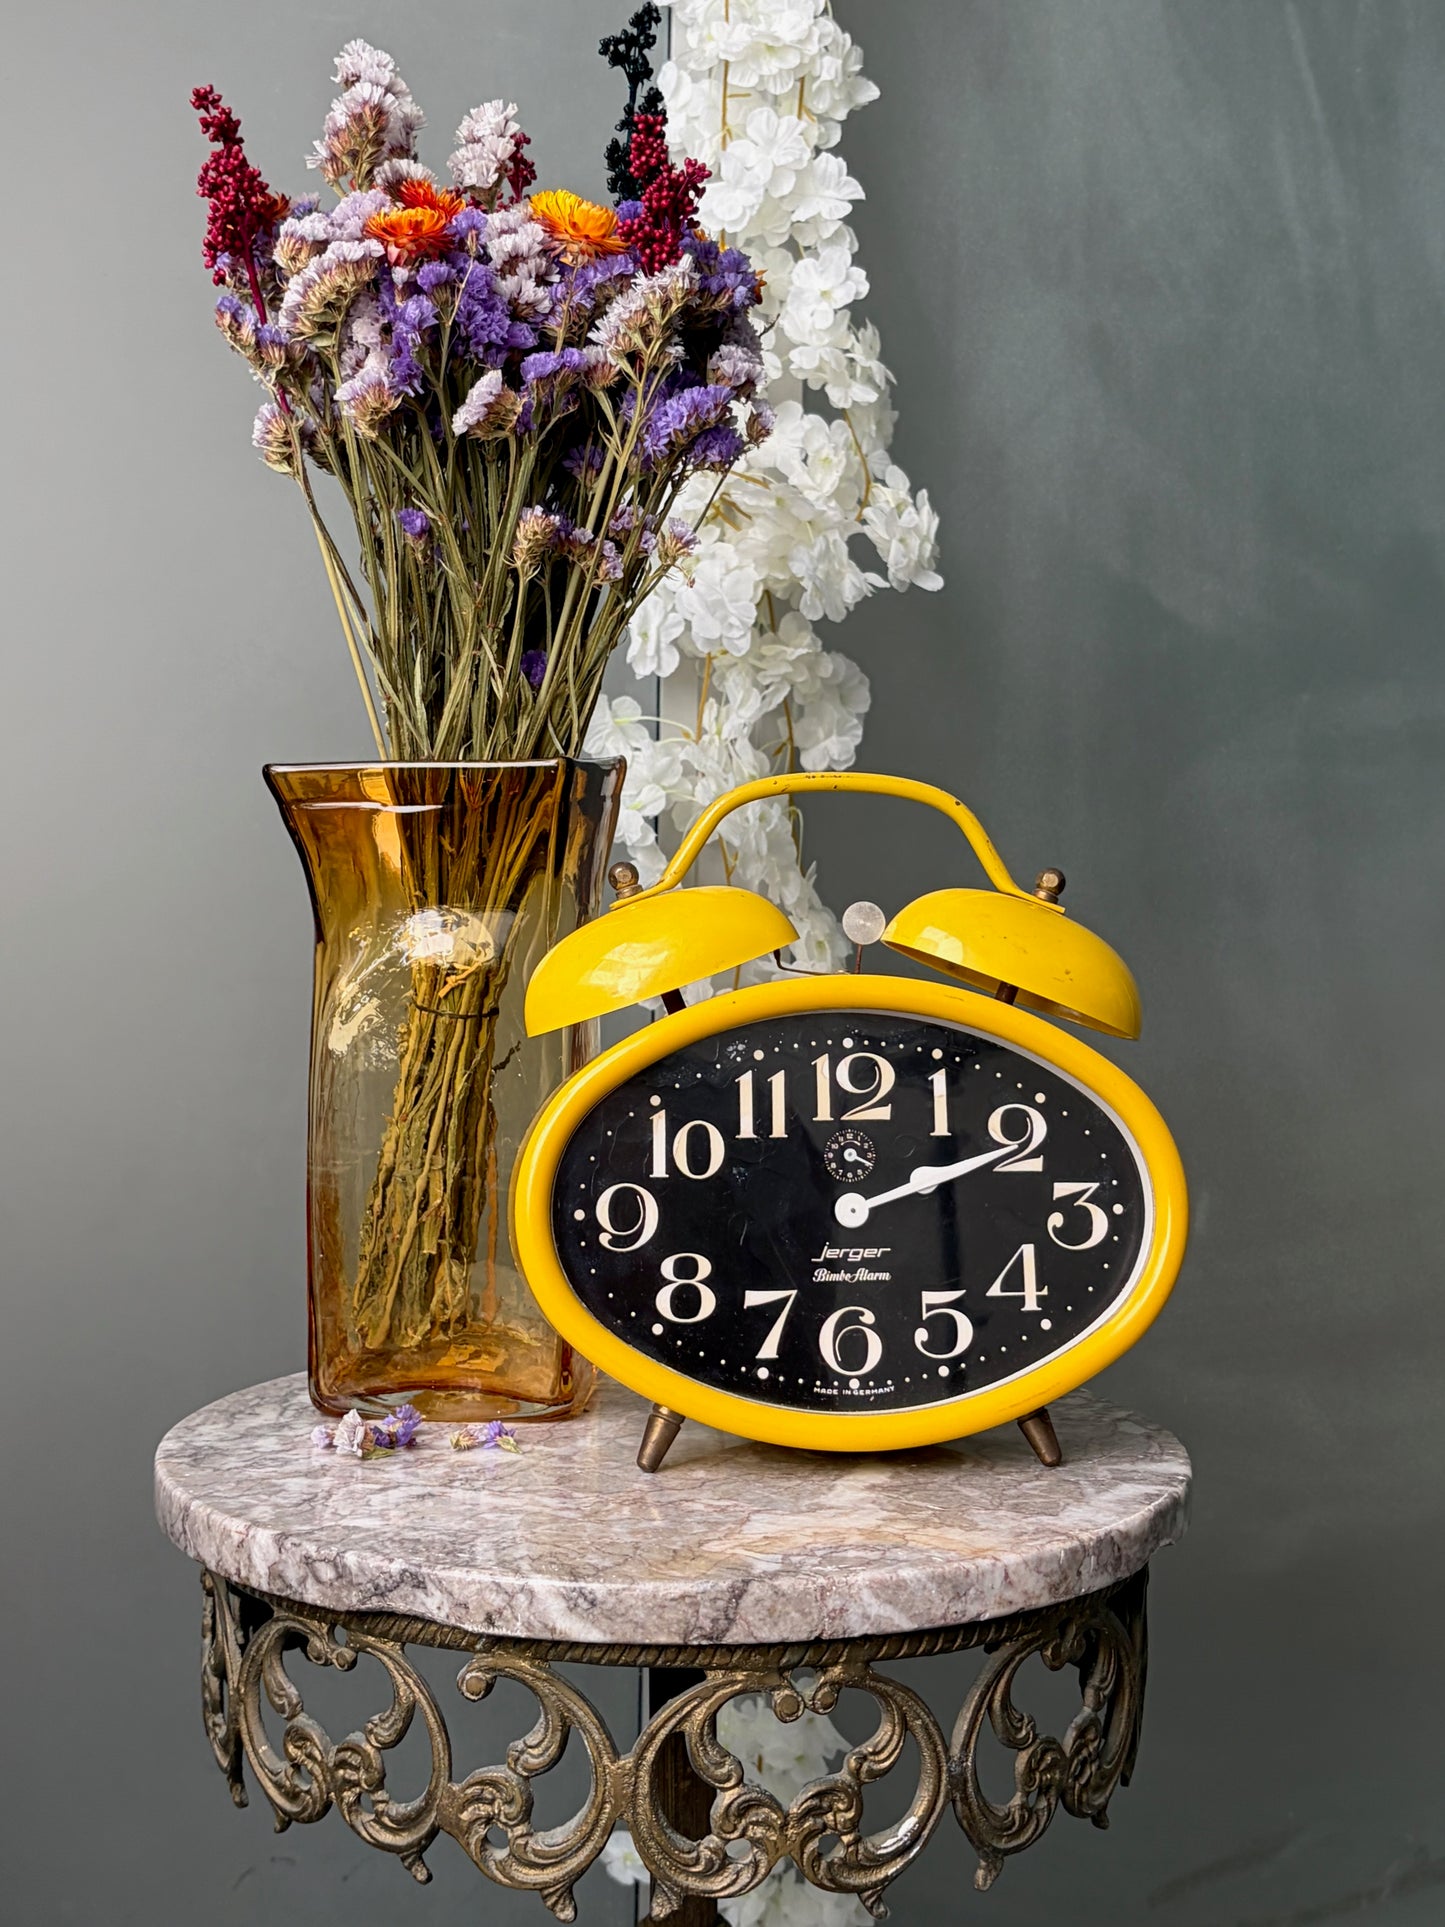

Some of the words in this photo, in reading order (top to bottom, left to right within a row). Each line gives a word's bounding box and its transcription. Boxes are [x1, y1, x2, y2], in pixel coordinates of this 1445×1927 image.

[734, 1069, 789, 1139] 11
[810, 1052, 896, 1122] 12
[928, 1068, 952, 1137] 1
[649, 1108, 726, 1180] 10
[986, 1103, 1047, 1172] 2
[595, 1182, 659, 1252] 9
[811, 1241, 891, 1262] jerger
[1047, 1182, 1109, 1251] 3
[655, 1252, 717, 1323] 8
[848, 1267, 892, 1283] Alarm
[986, 1243, 1049, 1312] 4
[743, 1289, 798, 1359] 7
[818, 1306, 883, 1376] 6
[914, 1289, 974, 1359] 5
[813, 1386, 839, 1395] MADE
[852, 1385, 895, 1396] GERMANY
